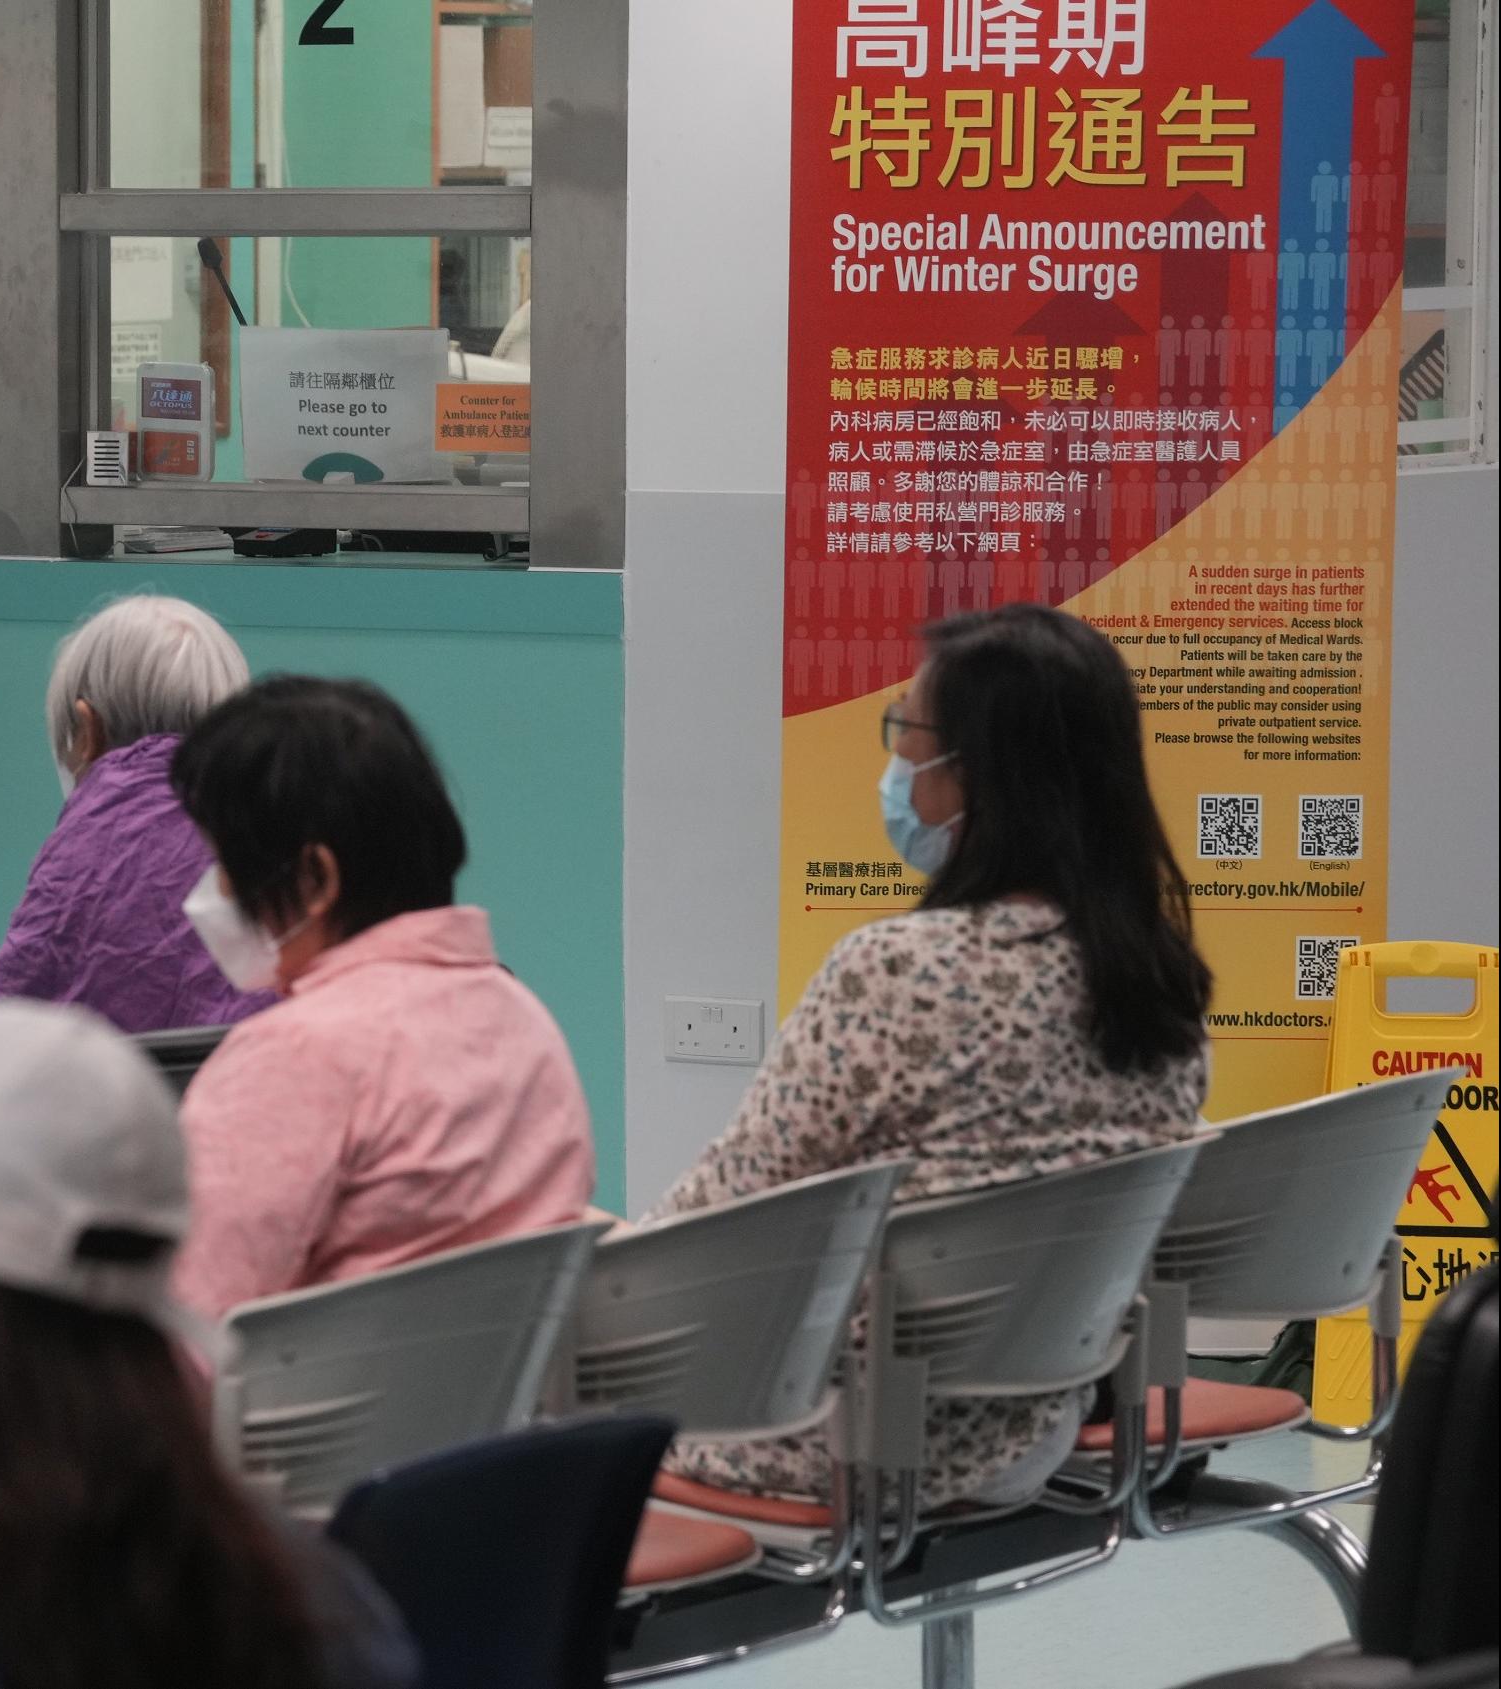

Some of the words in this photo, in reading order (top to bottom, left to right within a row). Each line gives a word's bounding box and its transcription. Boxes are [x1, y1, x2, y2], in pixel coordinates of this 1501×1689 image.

[835, 0, 1147, 78] 高峰期
[829, 84, 1256, 189] 特別通告
[832, 213, 968, 257] Special
[979, 213, 1267, 250] Announcement
[832, 256, 884, 292] for
[894, 256, 1016, 292] Winter
[1027, 255, 1139, 300] Surge
[288, 371, 396, 390] 請往隔鄰櫃位
[830, 377, 1116, 400] 輪候時間將會進一步延長。
[299, 399, 345, 413] Please
[349, 403, 367, 417] go
[371, 401, 387, 414] to
[460, 395, 499, 406] Counter
[502, 395, 516, 406] for
[443, 410, 497, 420] Ambulance
[499, 410, 531, 420] Patien
[298, 424, 328, 436] next
[332, 424, 391, 437] counter
[827, 501, 1082, 523] 請考慮使用私營門診服務。
[1188, 565, 1198, 578] A
[1201, 565, 1249, 579] sudden
[1253, 567, 1292, 581] surge
[1295, 566, 1307, 579] in
[1312, 566, 1365, 581] patients
[1194, 582, 1207, 594] in
[1210, 583, 1252, 595] recent
[1256, 582, 1288, 597] days
[1292, 583, 1316, 596] has
[1320, 583, 1365, 596] further
[1170, 598, 1230, 611] extended
[1234, 599, 1255, 611] the
[1259, 599, 1309, 614] waiting
[1313, 599, 1343, 612] time
[1346, 599, 1364, 612] for
[1140, 615, 1150, 628] &
[1154, 615, 1225, 630] Emergency
[1229, 615, 1288, 628] services.
[1291, 617, 1331, 629] Access
[1334, 617, 1363, 629] block
[1112, 635, 1144, 645] occur
[1146, 634, 1166, 645] due
[1169, 634, 1180, 645] to
[1183, 633, 1200, 645] full
[1203, 635, 1262, 647] occupancy
[1265, 634, 1277, 645] of
[1280, 633, 1324, 646] Medical
[1326, 634, 1363, 646] Wards.
[1180, 649, 1225, 661] Patients
[1227, 650, 1247, 661] will
[1250, 650, 1264, 661] be
[1267, 650, 1299, 661] taken
[1302, 651, 1326, 661] care
[1330, 651, 1343, 663] by
[1346, 651, 1363, 661] the
[1149, 666, 1213, 679] Department
[1216, 666, 1245, 678] while
[1248, 667, 1297, 680] awaiting
[1300, 667, 1356, 678] admission
[1159, 685, 1184, 696] your
[1187, 683, 1265, 696] understanding
[1269, 684, 1289, 694] and
[1292, 684, 1362, 696] cooperation!
[1139, 700, 1180, 711] embers
[1183, 700, 1194, 711] of
[1197, 700, 1214, 711] the
[1217, 700, 1251, 712] public
[1254, 702, 1278, 713] may
[1281, 700, 1329, 711] consider
[1332, 700, 1362, 713] using
[1218, 716, 1256, 729] private
[1259, 717, 1316, 729] outpatient
[1319, 717, 1361, 728] service.
[1154, 732, 1190, 744] Please
[1193, 733, 1233, 744] browse
[1237, 733, 1254, 744] the
[1257, 733, 1309, 746] following
[1312, 733, 1361, 745] websites
[1243, 749, 1259, 760] for
[1262, 751, 1291, 761] more
[1294, 749, 1361, 761] information:
[805, 862, 903, 878] 基層醫療指南
[1310, 861, 1350, 872] (English)
[805, 883, 857, 899] Primary
[860, 882, 889, 896] Care
[893, 882, 926, 896] Direc
[1372, 1050, 1483, 1078] CAUTION
[1442, 1084, 1499, 1111] OOR
